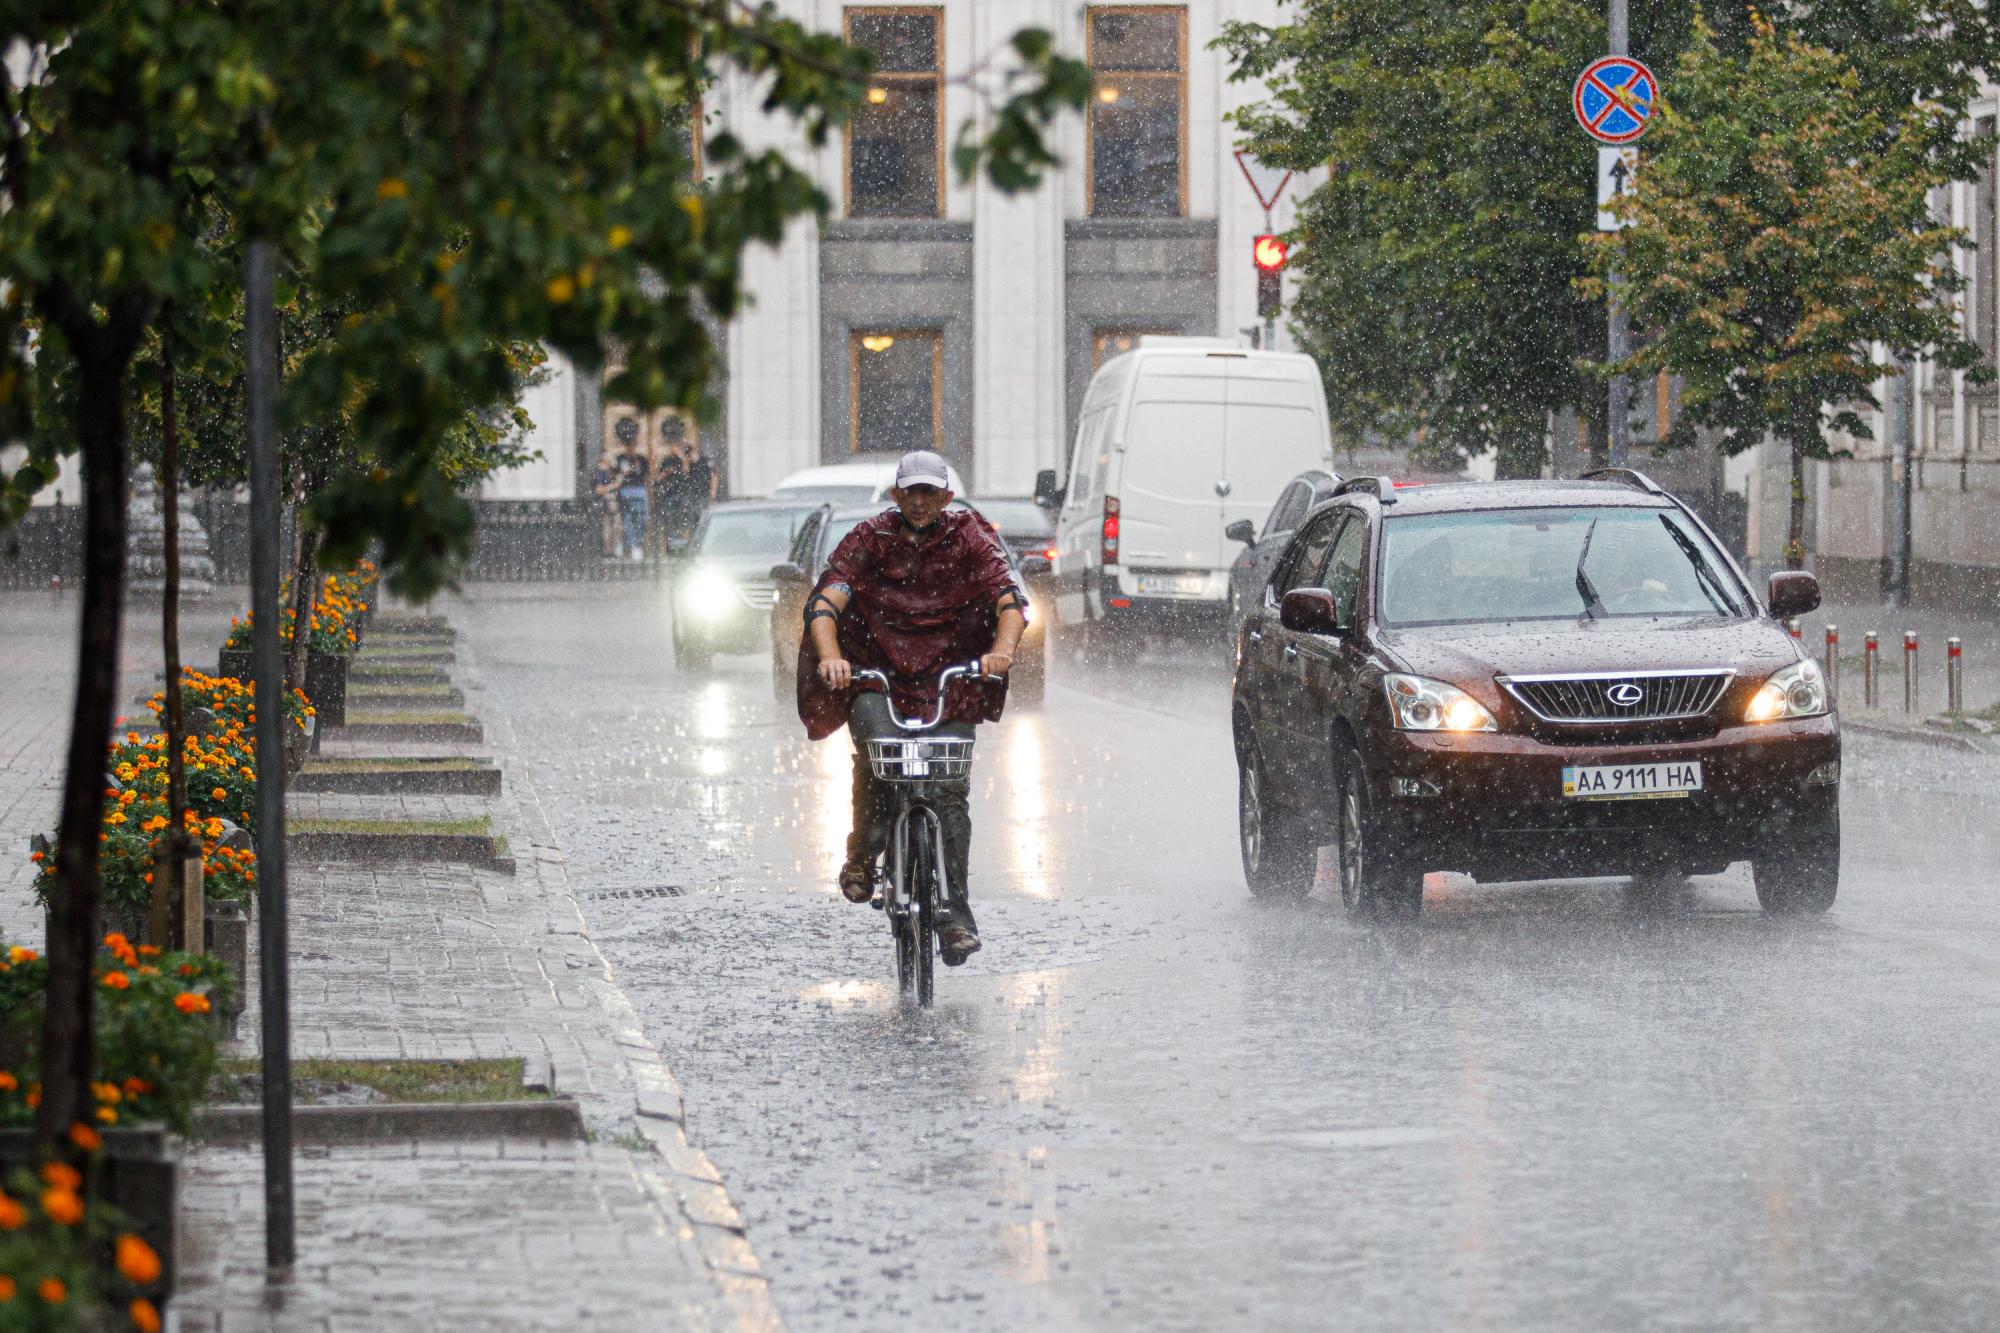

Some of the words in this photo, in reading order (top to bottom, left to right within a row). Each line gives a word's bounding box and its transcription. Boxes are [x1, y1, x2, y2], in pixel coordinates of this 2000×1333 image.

[1577, 770, 1606, 791] AA
[1612, 767, 1657, 790] 9111
[1666, 765, 1697, 787] HA
[1564, 785, 1575, 793] UA
